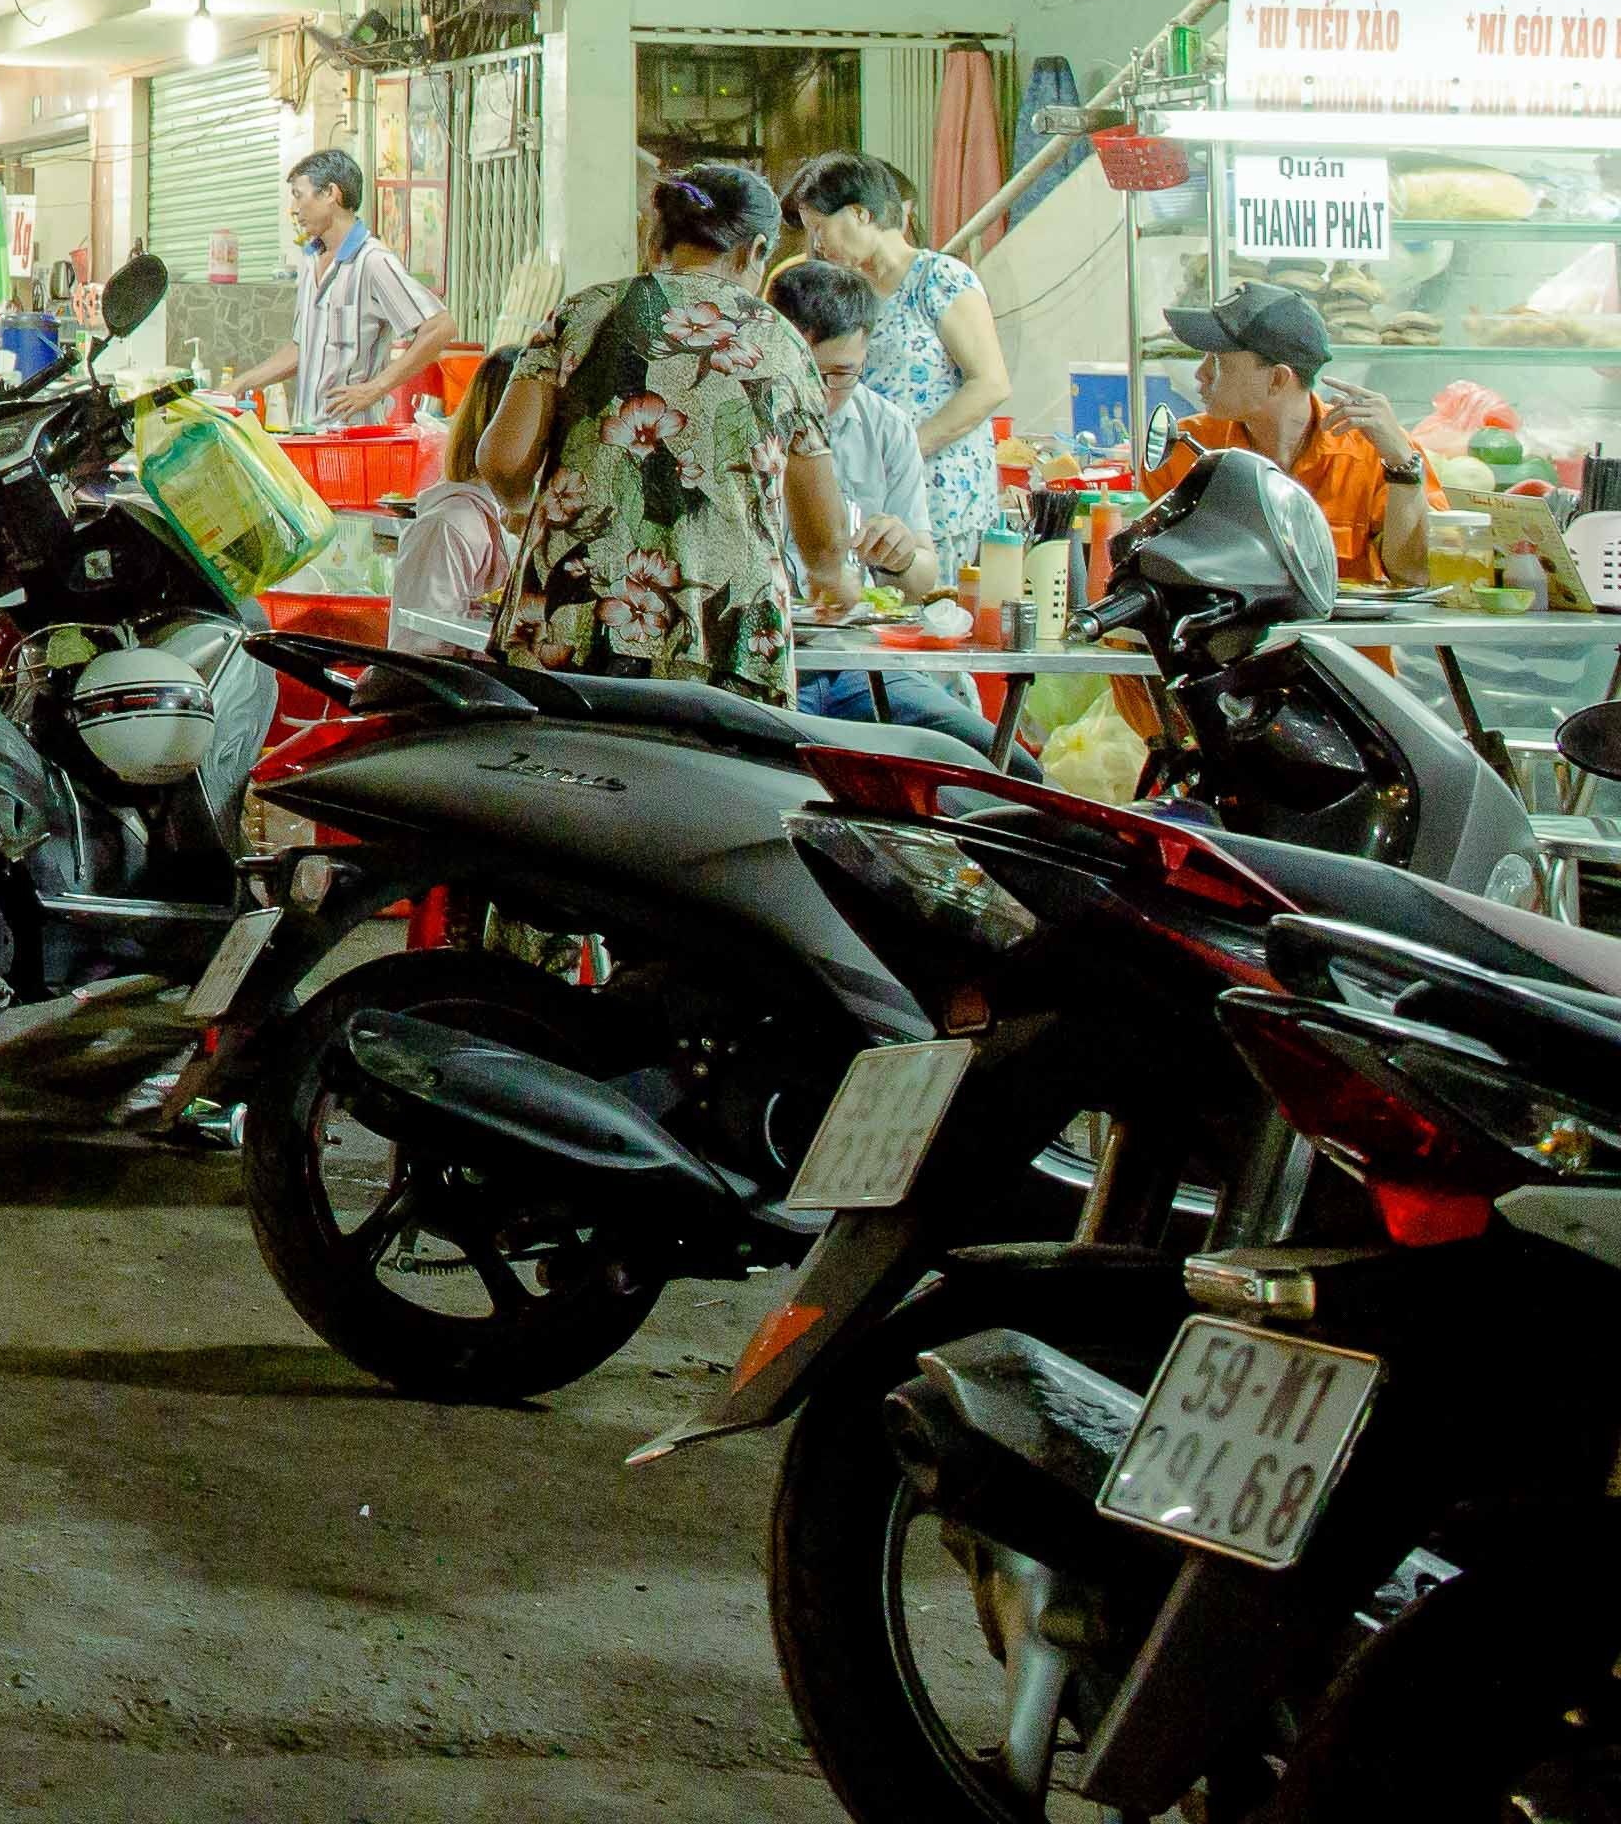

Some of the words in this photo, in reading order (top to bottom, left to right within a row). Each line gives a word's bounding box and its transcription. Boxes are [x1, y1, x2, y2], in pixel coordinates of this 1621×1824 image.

[1356, 0, 1400, 51] XÀO
[1514, 6, 1553, 56] GÓI
[1560, 8, 1606, 59] XÀO
[1279, 155, 1344, 180] Quán
[13, 211, 32, 269] Kg
[1240, 198, 1316, 247] THANH
[1326, 191, 1384, 249] PHÁT
